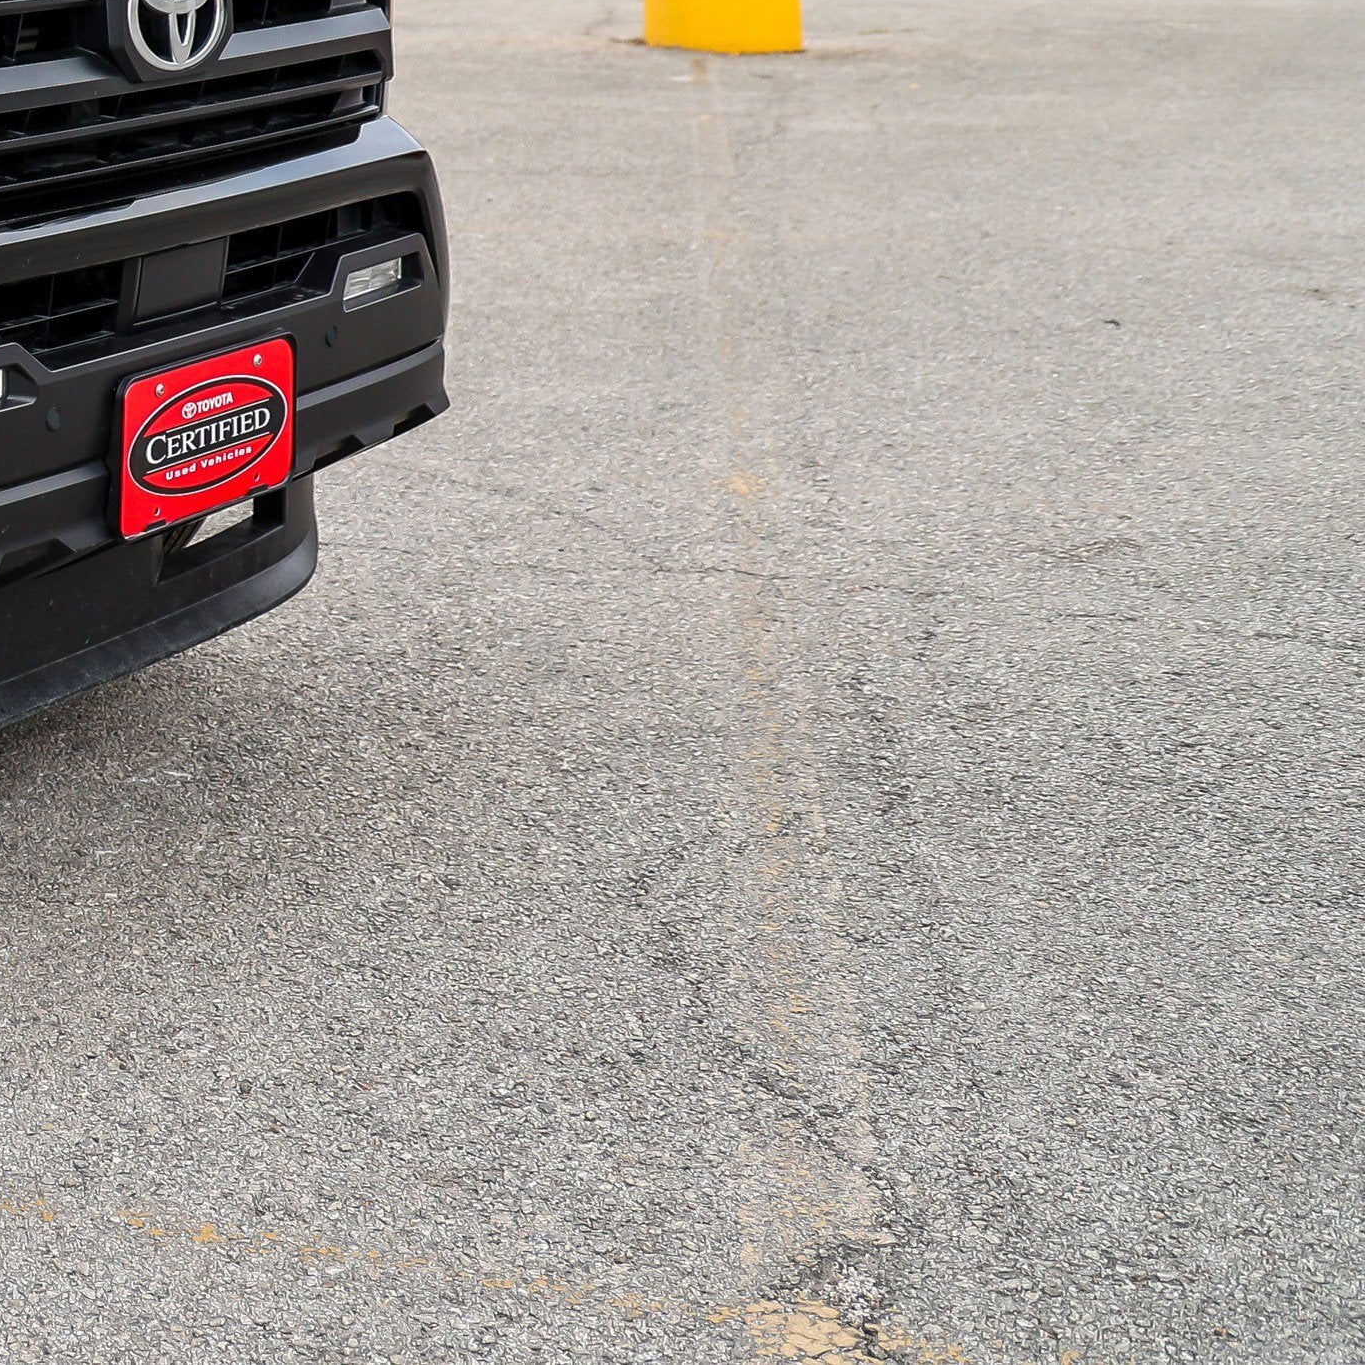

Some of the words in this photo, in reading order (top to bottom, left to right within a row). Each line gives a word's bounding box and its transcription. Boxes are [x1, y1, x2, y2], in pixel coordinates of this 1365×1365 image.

[197, 392, 233, 413] TOYOTA
[145, 407, 271, 465] CERTIFIED
[165, 462, 197, 481] Used
[200, 446, 253, 469] Vehicles
